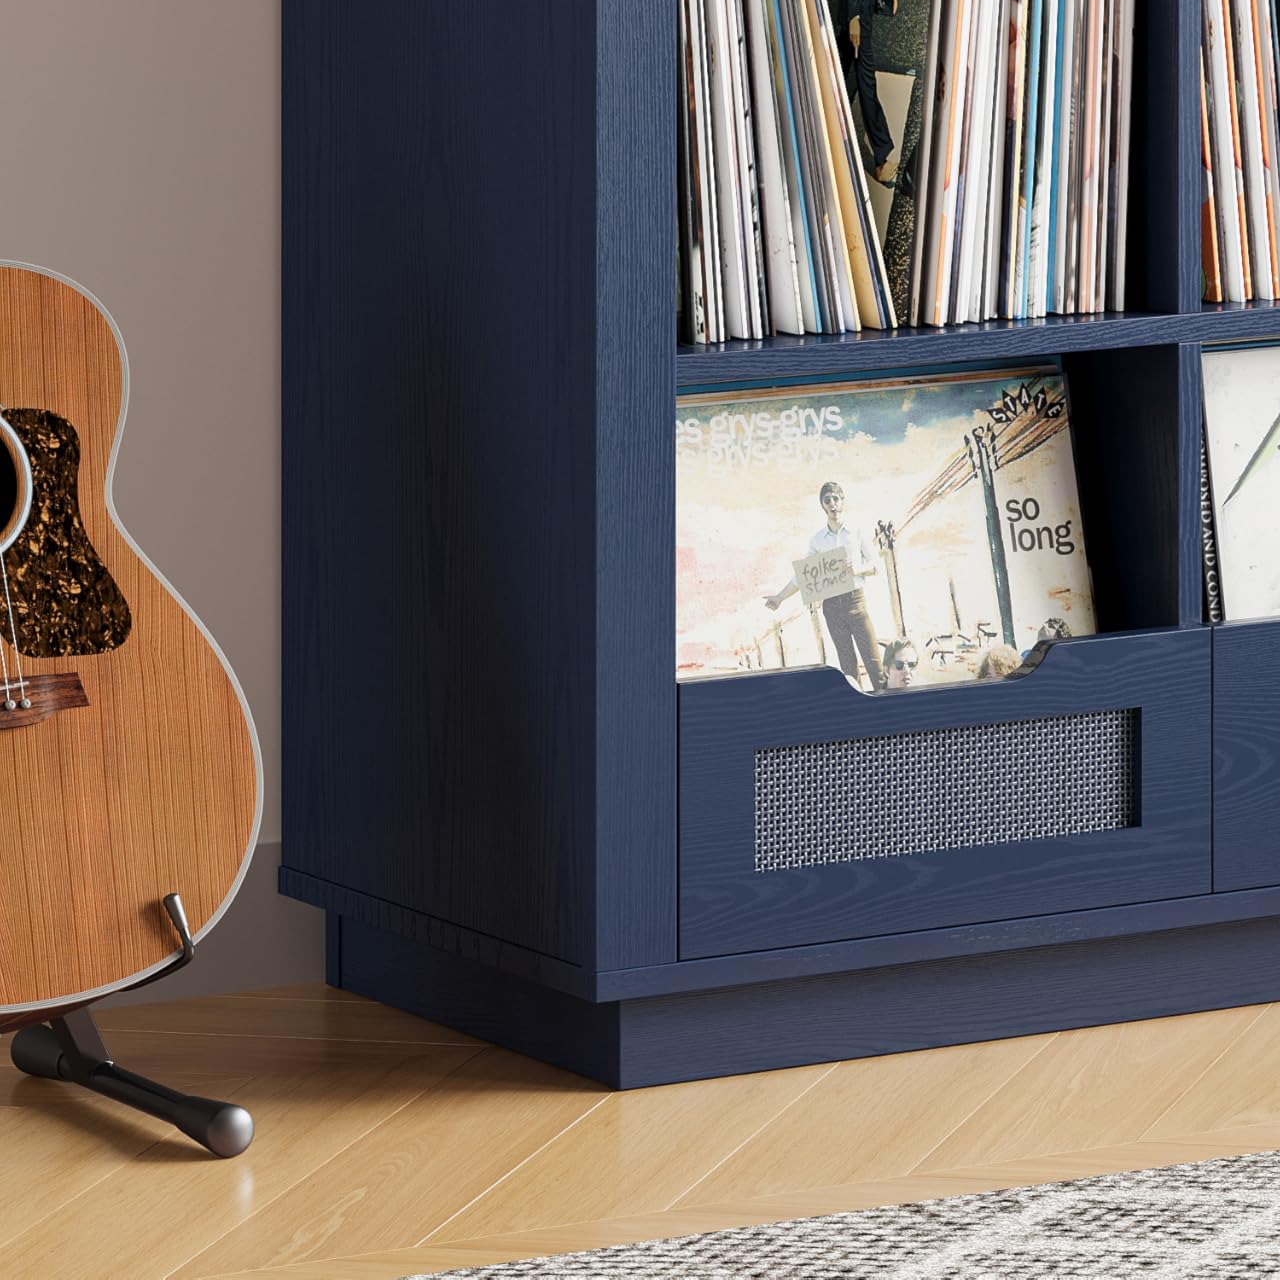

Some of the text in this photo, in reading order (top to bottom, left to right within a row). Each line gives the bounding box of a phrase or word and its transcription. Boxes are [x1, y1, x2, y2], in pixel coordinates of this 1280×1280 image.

[991, 387, 1062, 423] STATE
[709, 404, 844, 445] grys-grys
[1005, 497, 1040, 522] so
[1009, 520, 1076, 556] long
[1203, 527, 1215, 566] AND
[801, 554, 847, 583] folke-
[1206, 570, 1219, 622] COND
